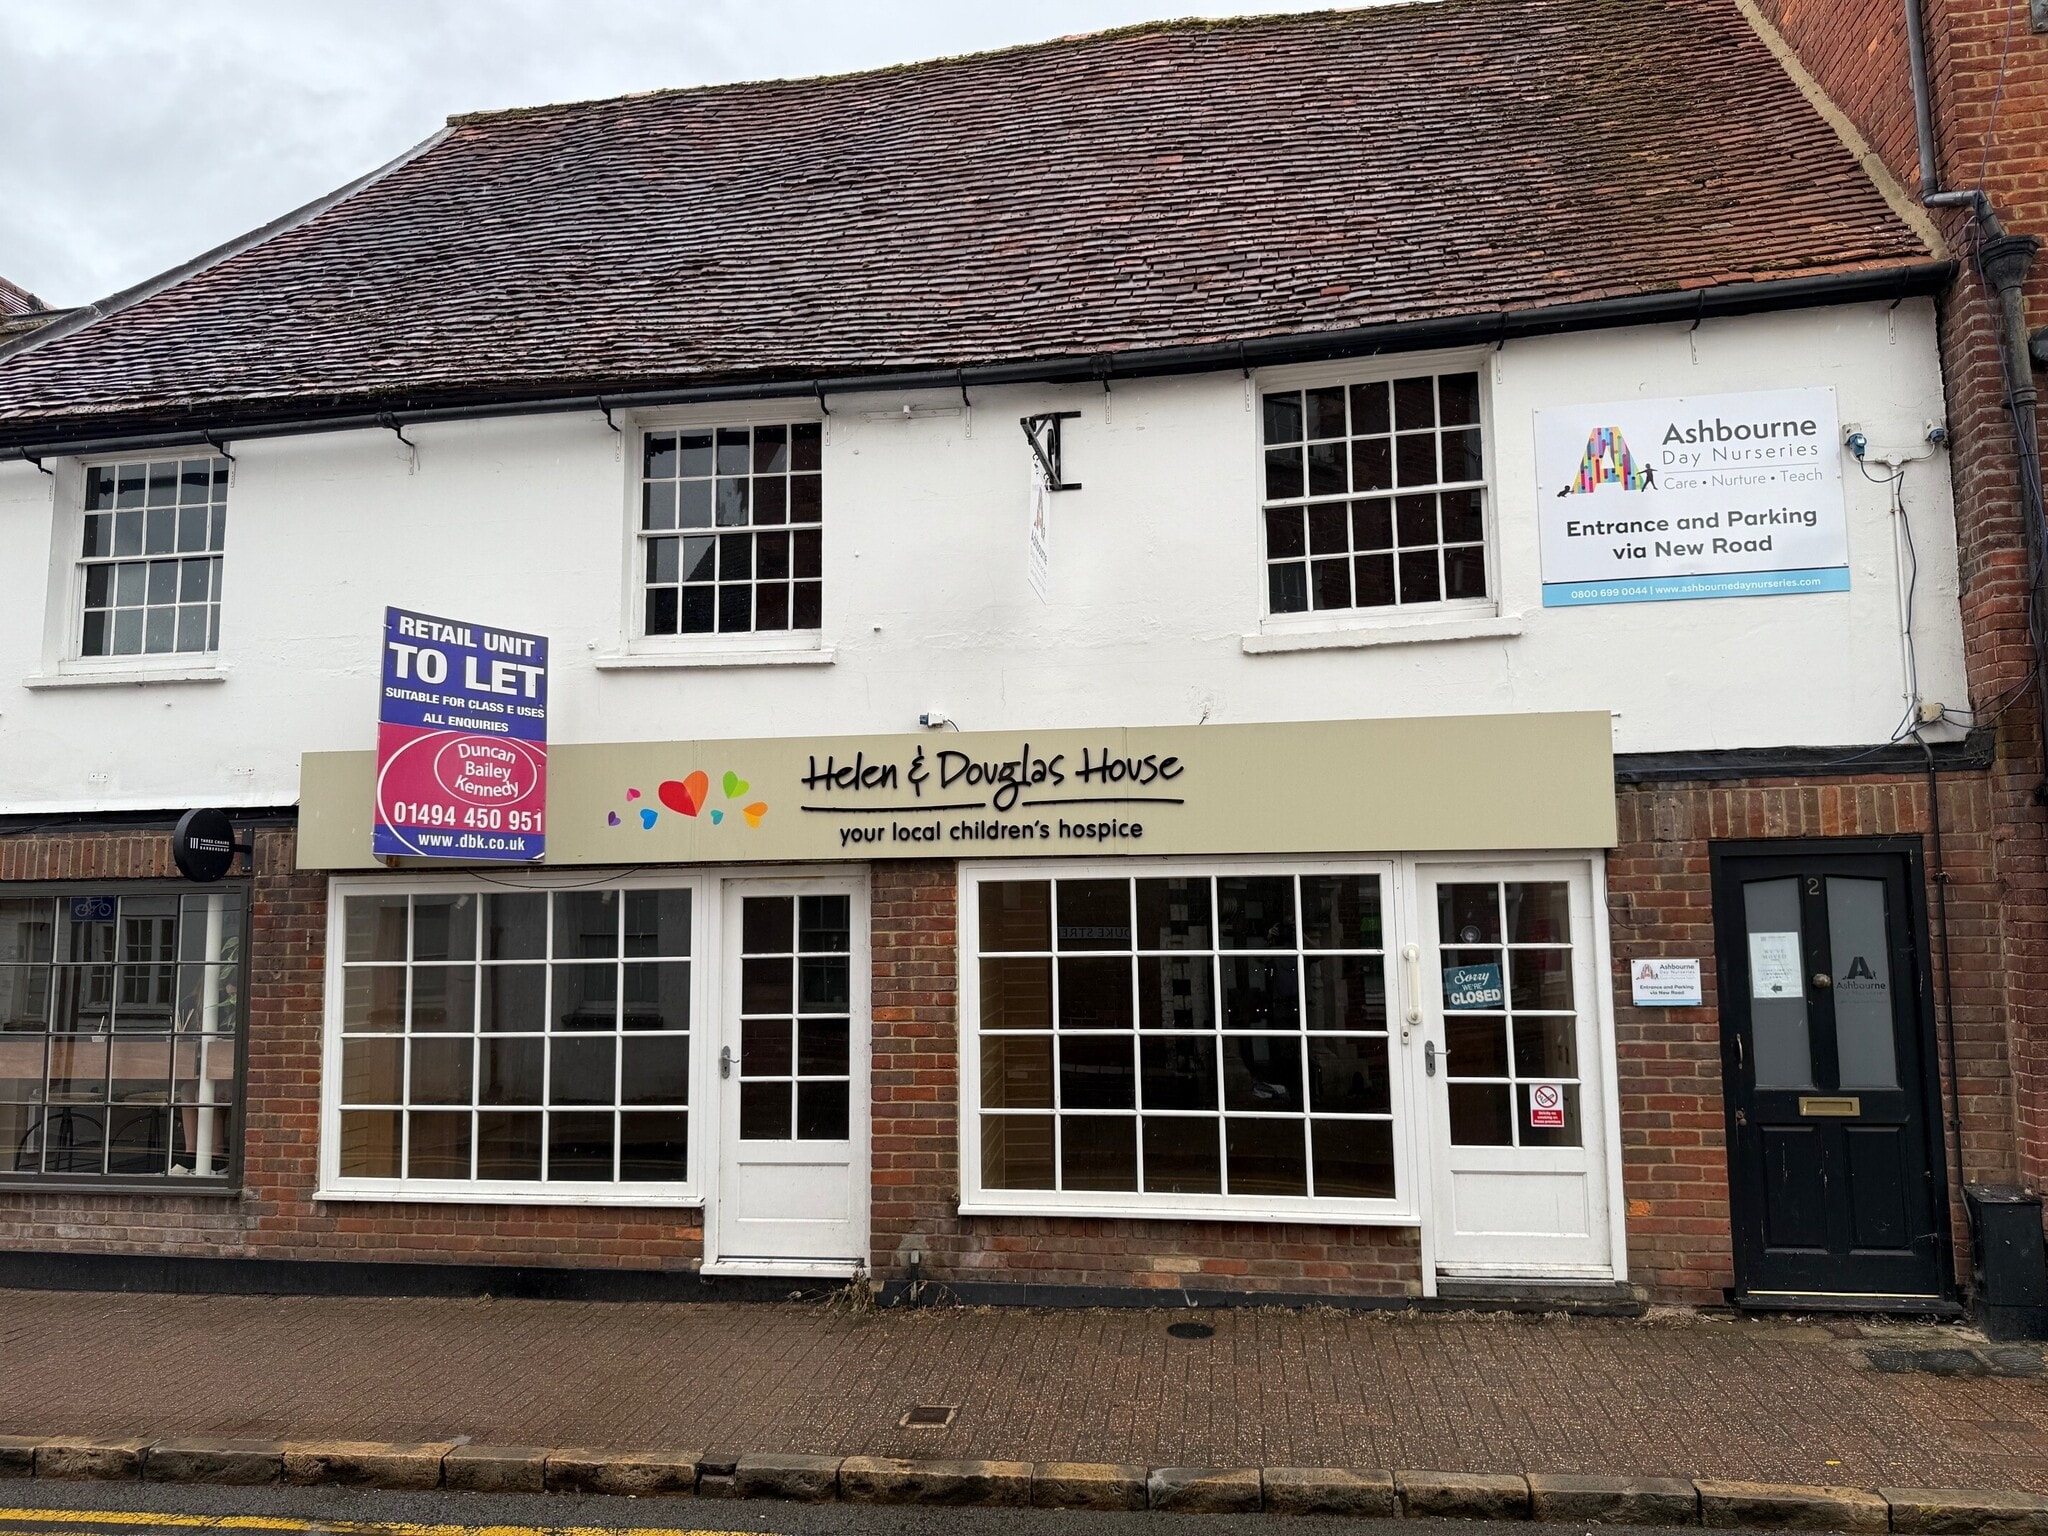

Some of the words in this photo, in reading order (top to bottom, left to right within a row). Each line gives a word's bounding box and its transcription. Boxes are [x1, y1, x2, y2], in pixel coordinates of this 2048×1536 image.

[1662, 418, 1817, 445] Ashbourne
[1663, 450, 1701, 467] Day
[1713, 444, 1818, 462] Nurseries
[1664, 476, 1697, 490] Care
[1712, 473, 1766, 487] Nurture
[1780, 469, 1823, 483] Teach
[1567, 516, 1669, 537] Entrance
[1676, 512, 1719, 531] and
[1727, 507, 1818, 528] Parking
[1612, 543, 1646, 560] via
[1654, 541, 1704, 557] New
[1712, 535, 1773, 554] Road
[1571, 590, 1598, 599] 0800
[1599, 588, 1620, 597] 699
[1621, 587, 1648, 596] 0044
[1655, 576, 1821, 594] www.ashbournedaynurseries.com
[399, 615, 477, 648] RETAIL
[484, 632, 535, 657] UNIT
[389, 641, 448, 684] TO
[465, 656, 544, 698] LET
[386, 687, 439, 704] SUITABLE
[443, 696, 465, 708] FOR
[468, 699, 504, 713] CLASS
[507, 705, 514, 714] E
[517, 706, 545, 718] USES
[423, 713, 445, 726] ALL
[448, 715, 509, 733] ENQUIRIES
[458, 743, 517, 765] Duncan
[465, 761, 511, 782] Bailey
[801, 751, 897, 791] Helen
[907, 745, 929, 797] &
[937, 743, 1065, 812] Douglas
[1075, 747, 1184, 785] House
[454, 774, 519, 798] Kennedy
[394, 802, 456, 826] 01494
[464, 808, 501, 829] 450
[508, 811, 542, 832] 951
[418, 834, 525, 851] www.dbk.co.uk
[840, 825, 884, 847] your
[893, 820, 940, 841] local
[949, 818, 1050, 840] children's
[1059, 818, 1143, 842] hospice
[1807, 878, 1820, 895] 2
[1454, 970, 1489, 986] Sorry
[1836, 980, 1886, 989] Ashbourne
[1451, 989, 1501, 1005] CLOSED
